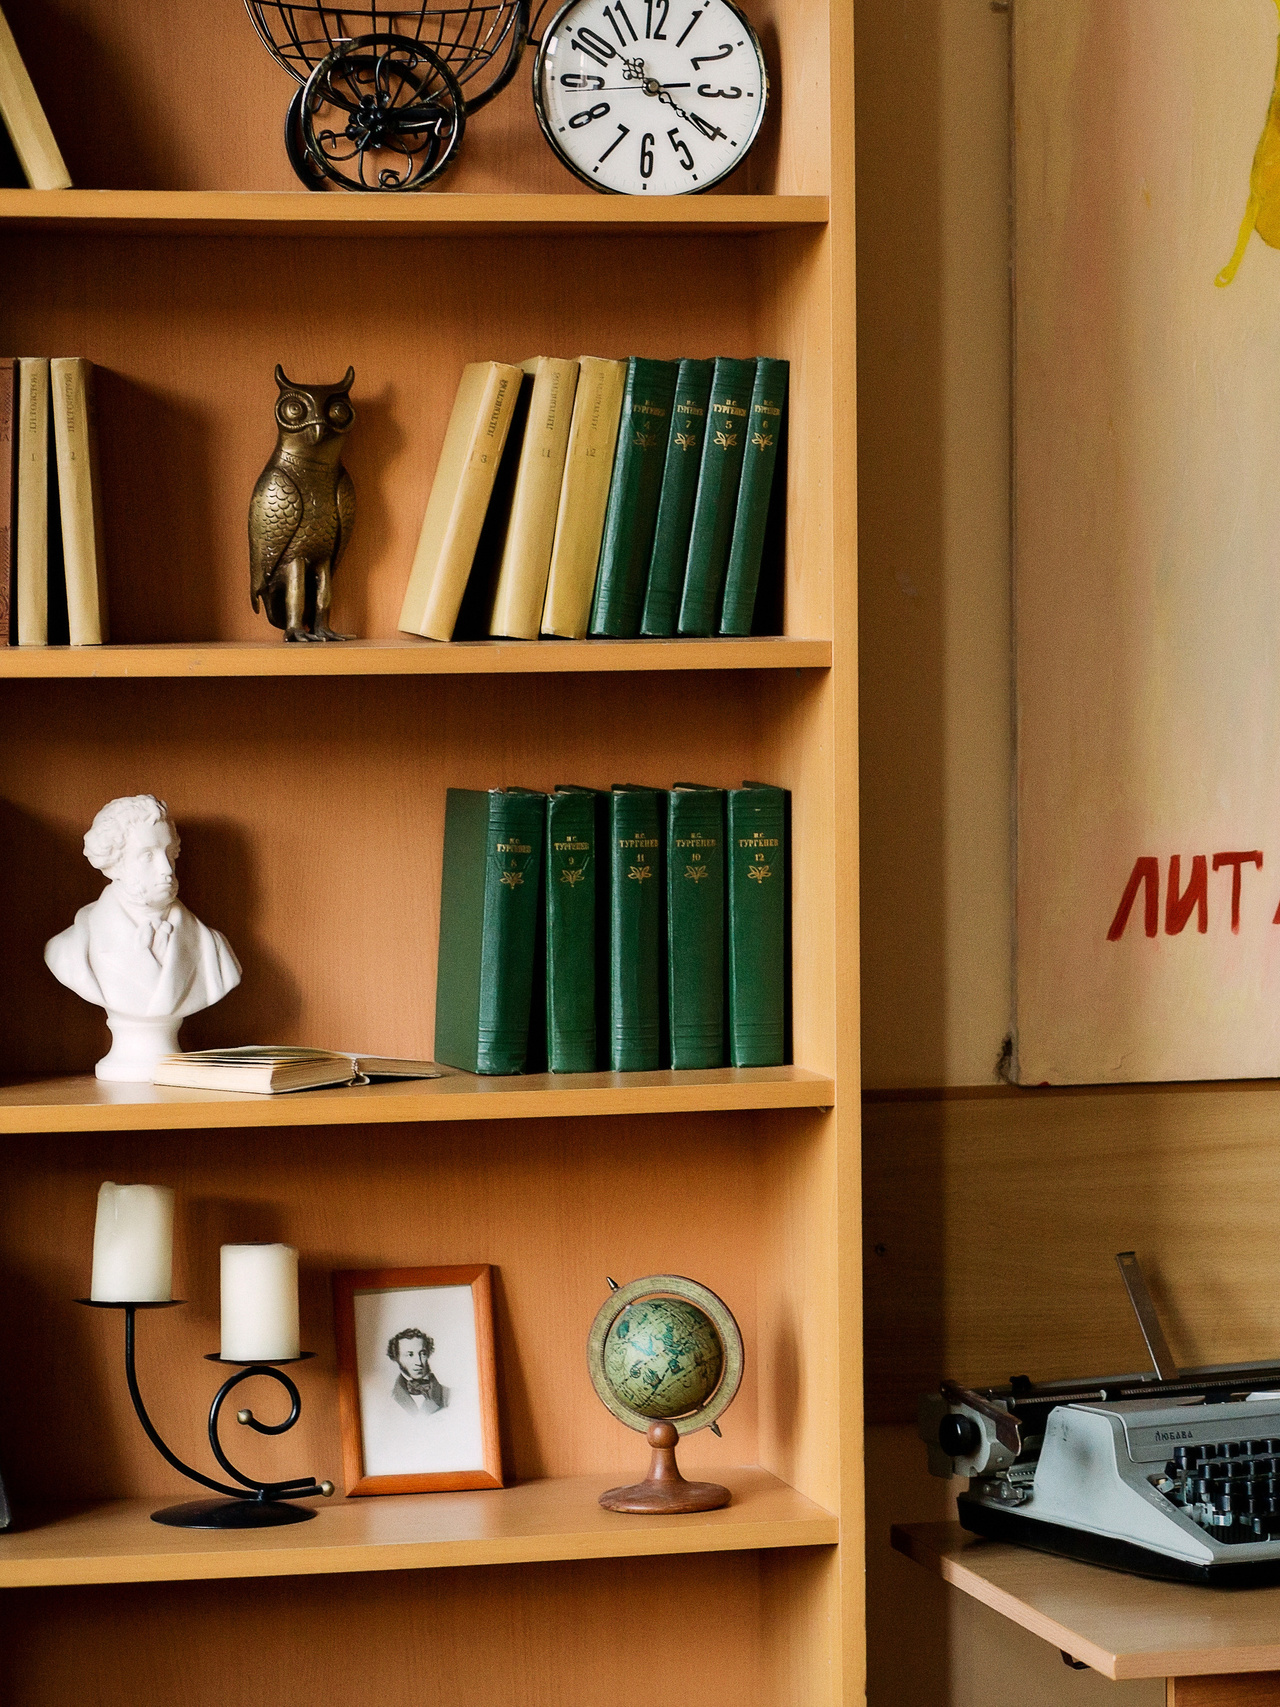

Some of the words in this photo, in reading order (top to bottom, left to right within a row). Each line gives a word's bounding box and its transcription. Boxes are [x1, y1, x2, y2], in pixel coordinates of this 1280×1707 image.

[602, 0, 639, 47] 11
[644, 0, 670, 40] 12
[676, 10, 703, 48] 1
[571, 27, 616, 68] 10
[690, 43, 734, 71] 2
[560, 73, 605, 90] 9
[697, 83, 742, 99] 3
[568, 102, 611, 129] 8
[689, 112, 728, 142] 4
[598, 123, 631, 163] 7
[667, 127, 694, 171] 5
[639, 132, 655, 178] 6
[677, 404, 704, 416] ТУРГЕНЕВ
[713, 404, 747, 416] ТУРГЕНЕВ
[754, 405, 780, 415] ТУРГЕНЕВ
[685, 420, 692, 428] 7
[725, 420, 733, 429] 5
[762, 420, 769, 428] 6
[480, 454, 487, 464] 3
[554, 842, 590, 850] ТУРГЕНЕВ
[619, 839, 659, 848] ТУРГЕНЕВ
[676, 838, 716, 848] ТУРГЕНЕВ
[739, 838, 779, 848] ТУРГЕНЕВ
[568, 857, 575, 865] 9
[636, 853, 645, 862] 11
[691, 853, 701, 862] 10
[754, 853, 765, 862] 12
[1107, 850, 1264, 941] ЛИТ
